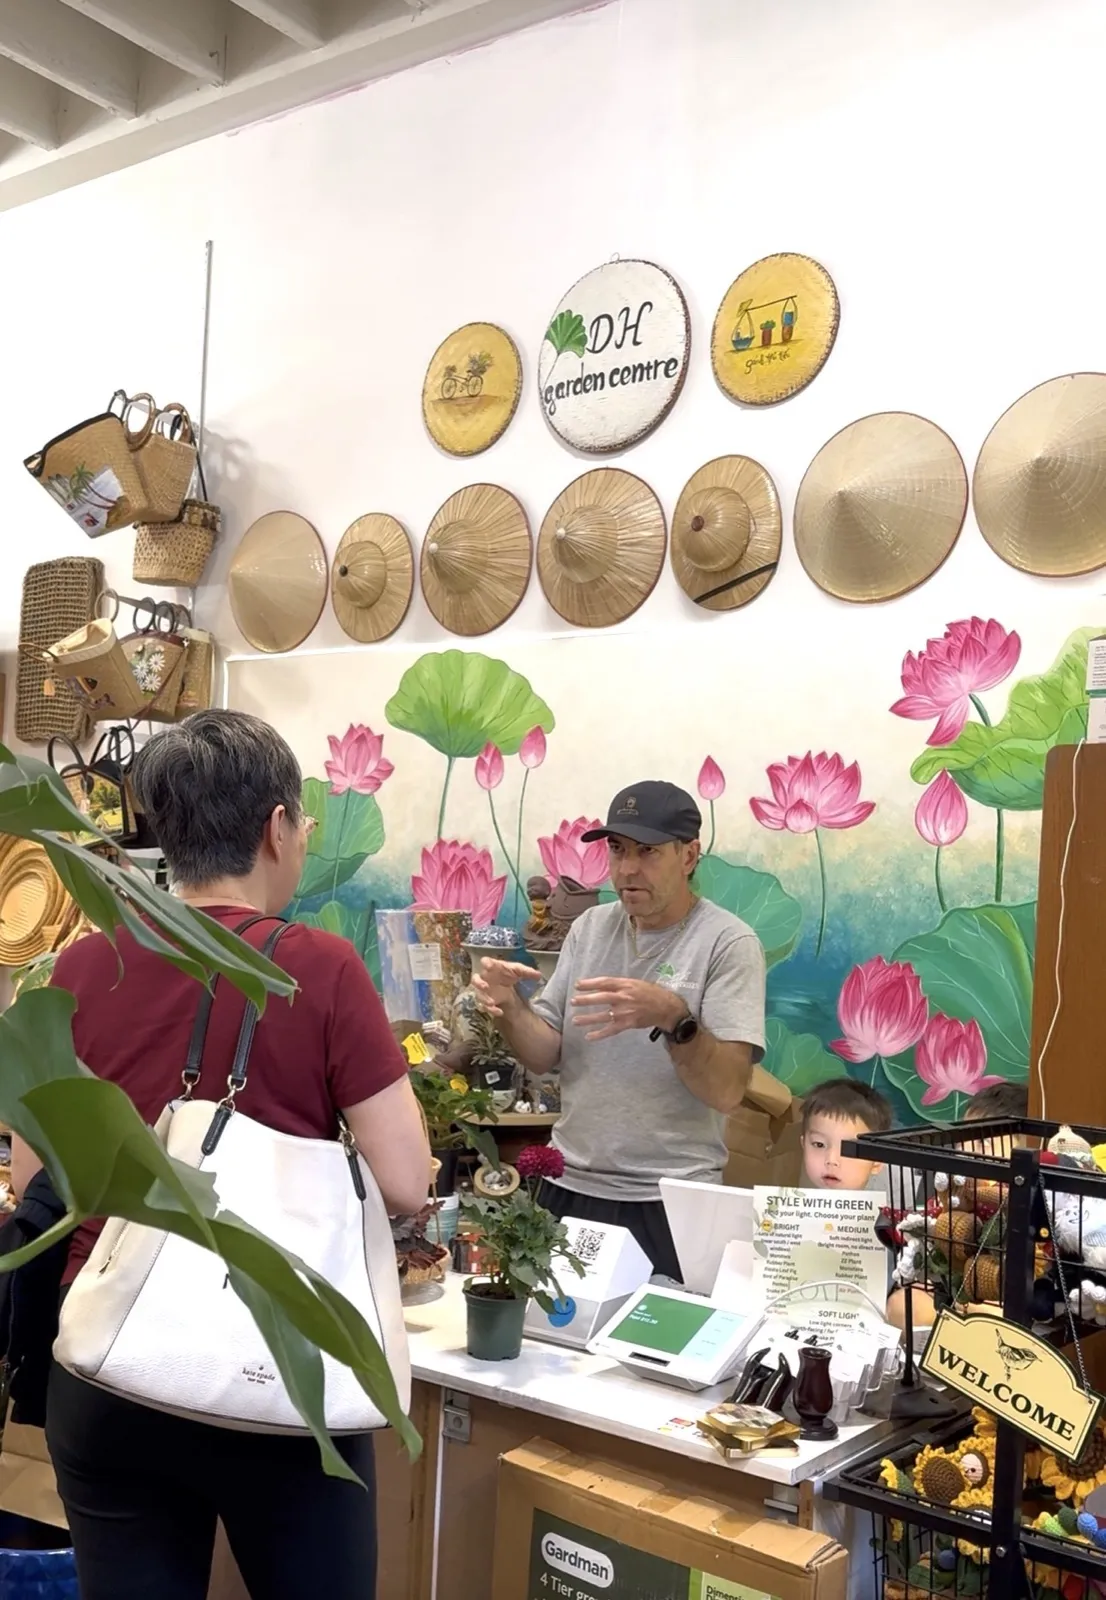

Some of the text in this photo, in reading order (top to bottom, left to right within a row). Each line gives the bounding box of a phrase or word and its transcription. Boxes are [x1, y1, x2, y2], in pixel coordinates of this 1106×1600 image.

[585, 300, 653, 354] DH
[544, 357, 678, 416] garden centre
[766, 1195, 873, 1211] STYLE WITH GREEN
[795, 1210, 812, 1219] light.
[814, 1211, 839, 1219] Choose
[857, 1214, 875, 1222] plant
[774, 1223, 800, 1231] BRIGHT
[837, 1225, 869, 1234] MEDIUM
[818, 1310, 837, 1318] SOFT
[938, 1345, 1075, 1441] WELCOME
[545, 1540, 608, 1580] Gardman
[540, 1572, 548, 1586] 4
[550, 1575, 574, 1598] Tier
